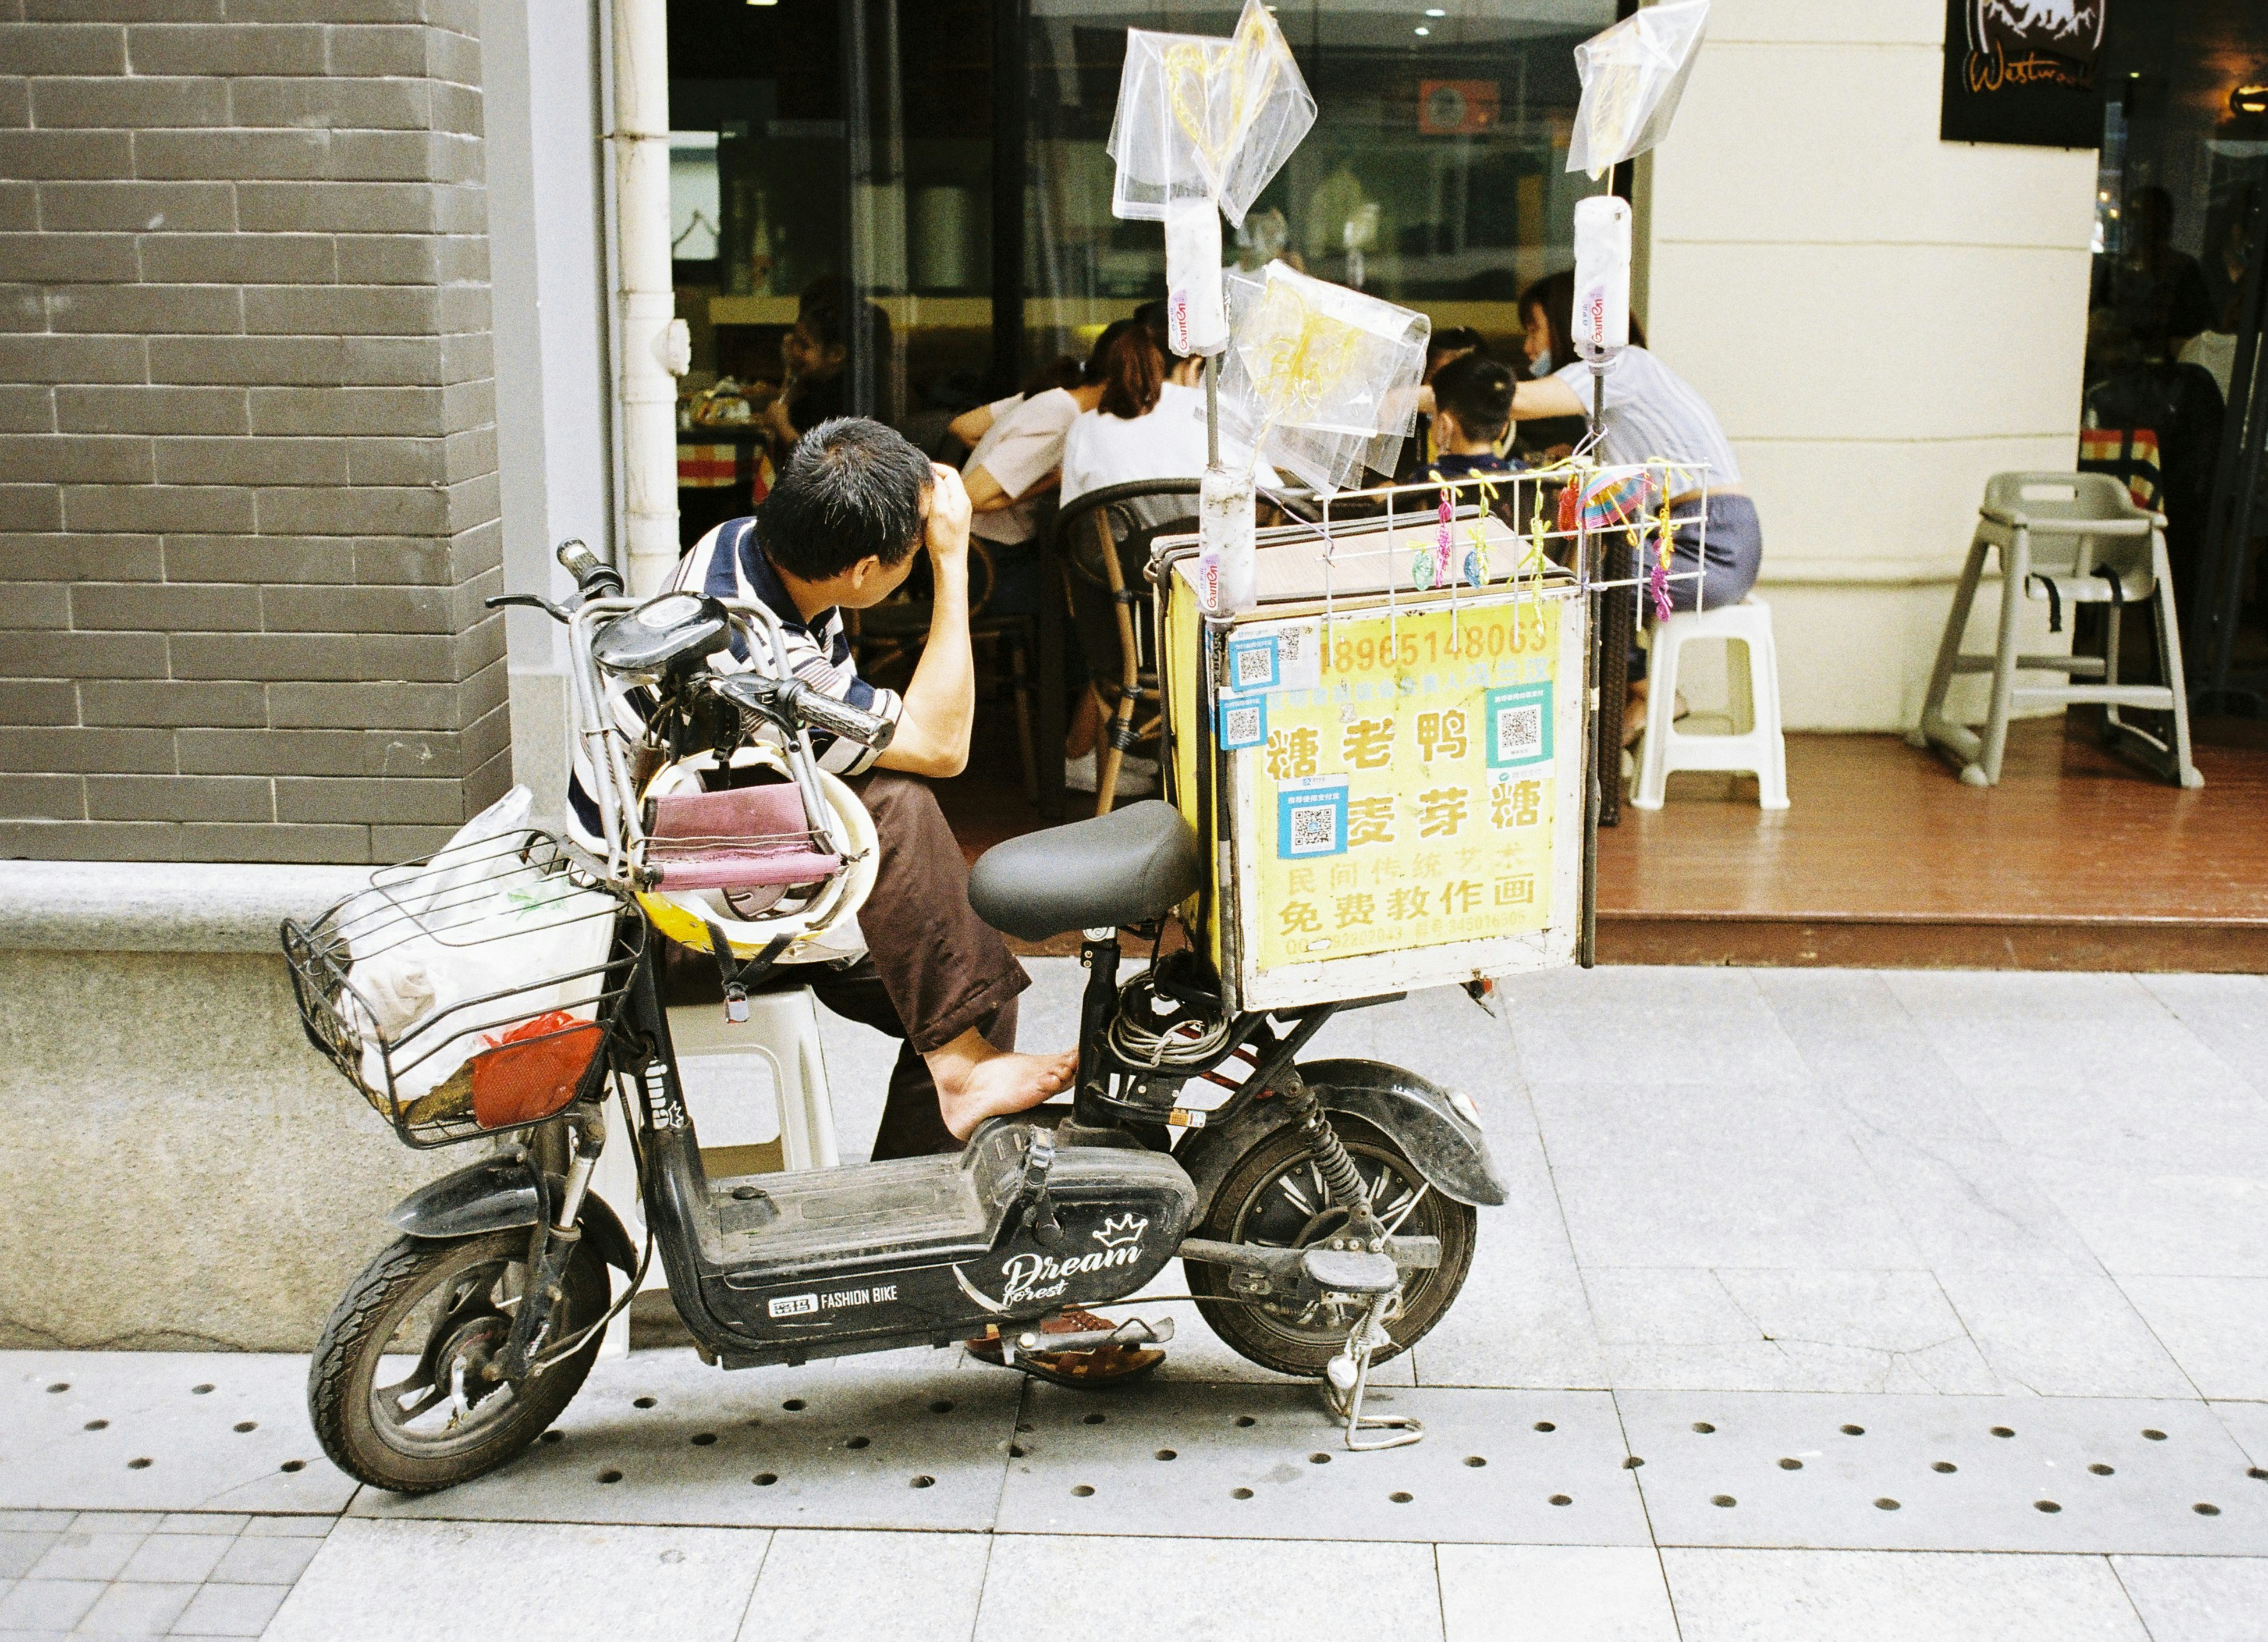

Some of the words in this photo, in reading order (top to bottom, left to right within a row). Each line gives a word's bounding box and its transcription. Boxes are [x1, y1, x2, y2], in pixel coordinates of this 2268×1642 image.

[1321, 619, 1548, 674] 18965148063
[1267, 709, 1467, 780] 糖老鸭
[1347, 780, 1541, 847] 麦芽糖
[1280, 873, 1535, 936] 免费教作画
[1002, 1246, 1143, 1292] Dream
[1002, 1278, 1069, 1308] forest
[821, 1289, 870, 1309] FASHION
[872, 1285, 898, 1303] BIKE
